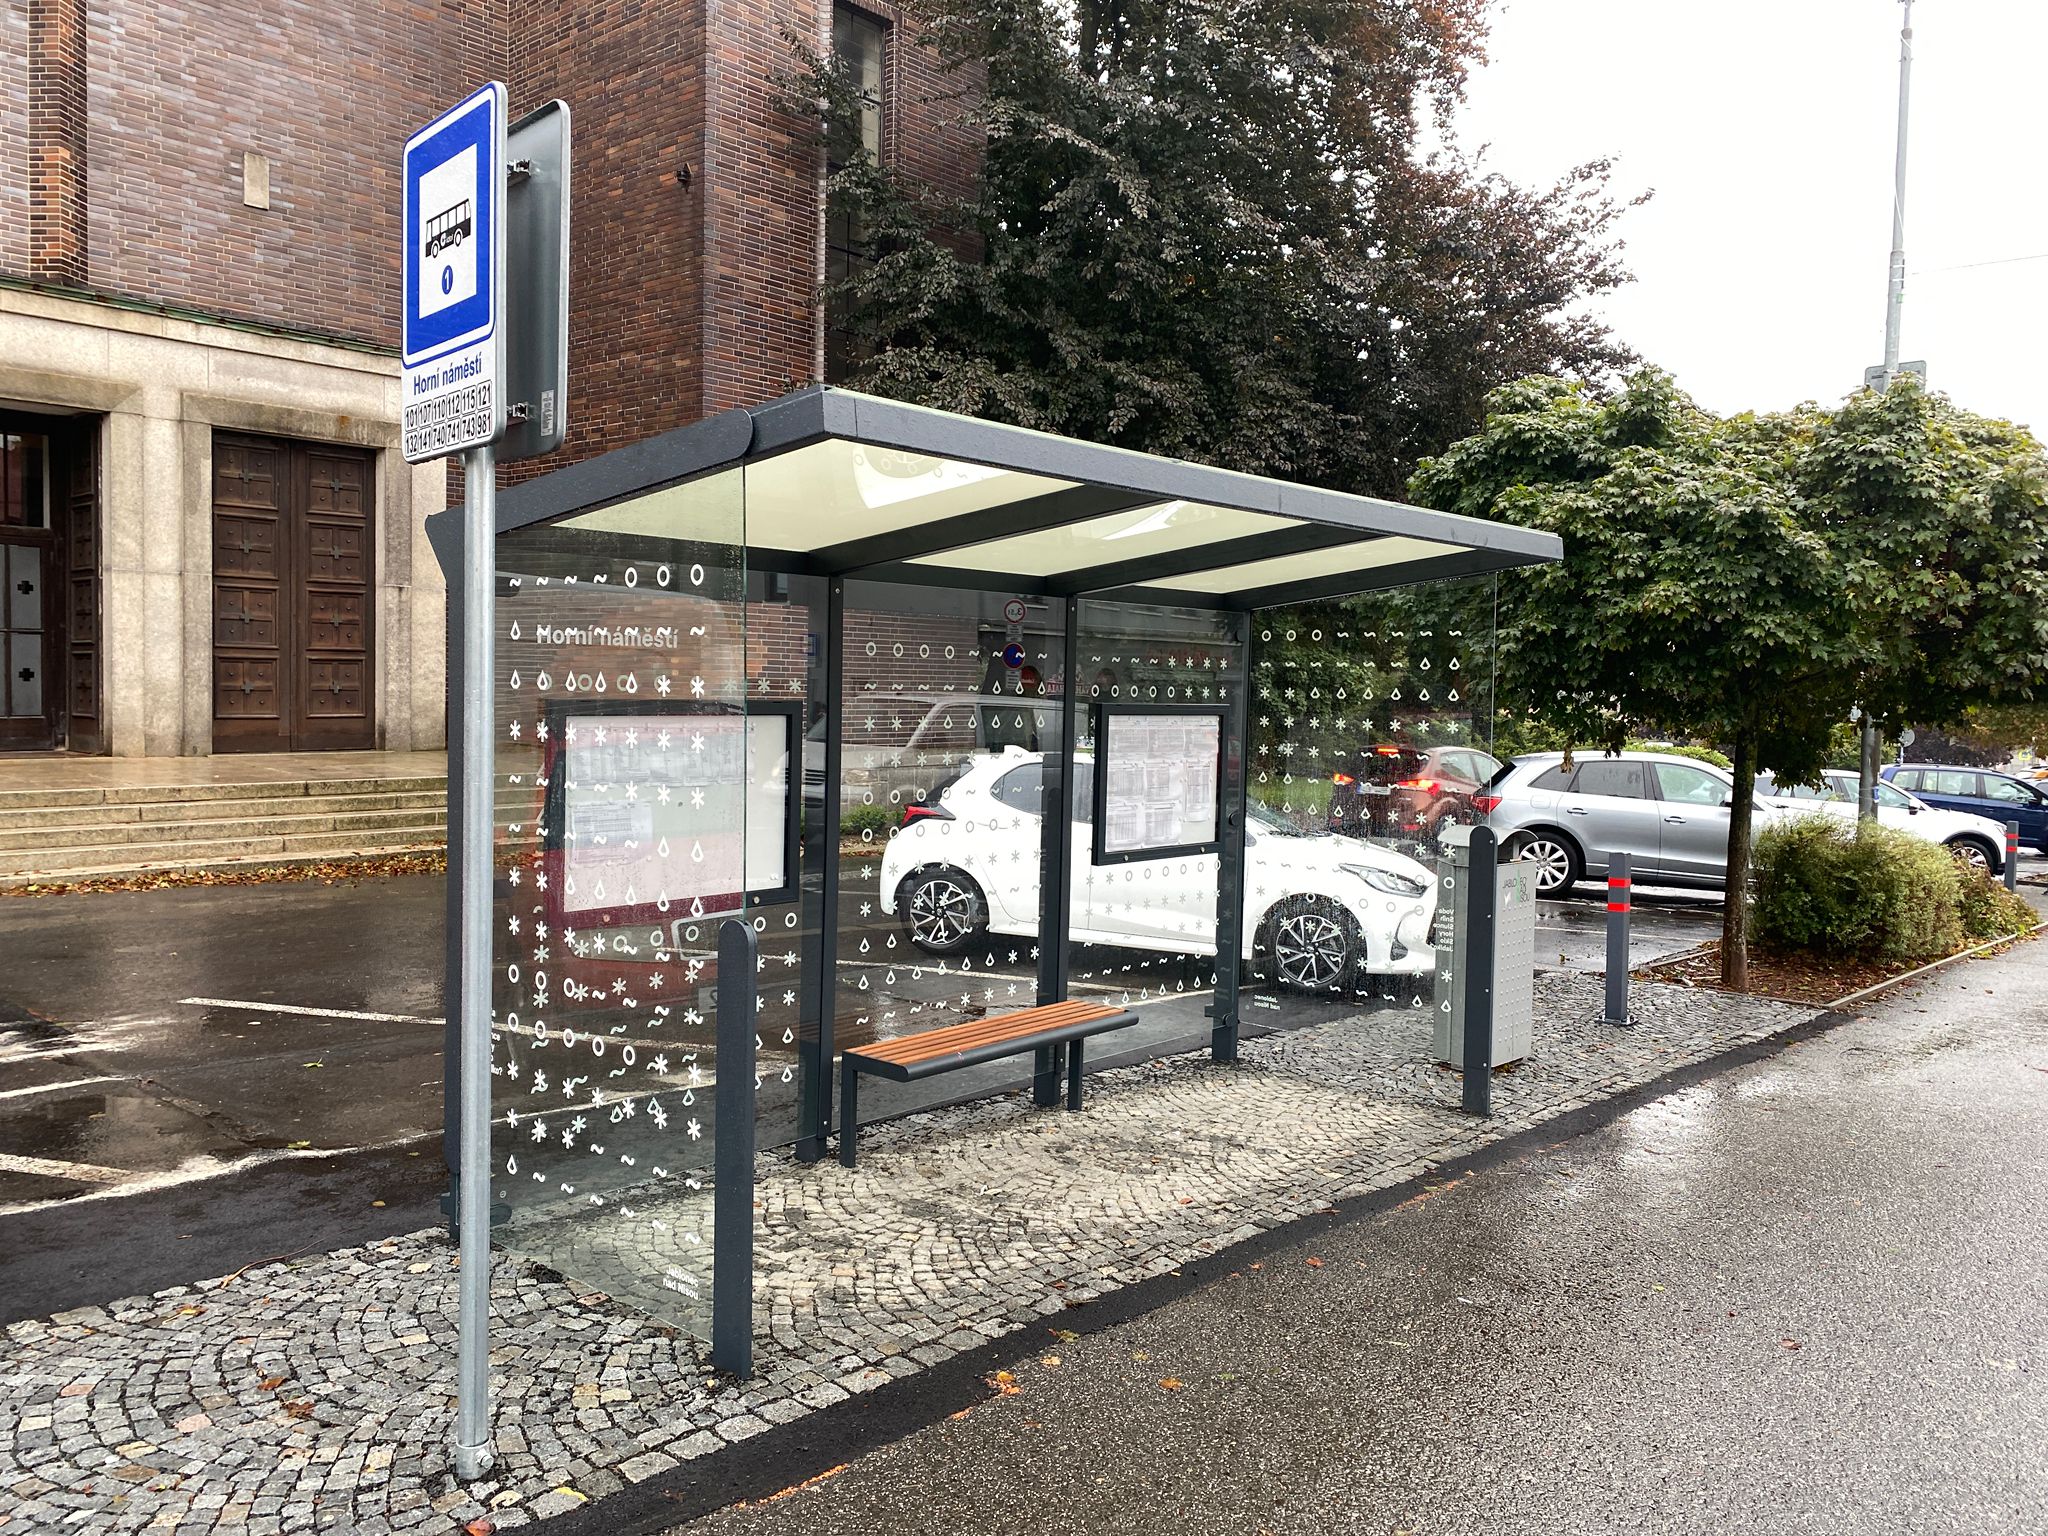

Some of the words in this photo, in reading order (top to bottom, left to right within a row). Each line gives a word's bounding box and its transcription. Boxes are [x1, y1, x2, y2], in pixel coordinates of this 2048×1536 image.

[414, 367, 440, 395] Horní
[442, 351, 482, 386] náměstí
[406, 408, 418, 428] 101
[419, 403, 431, 425] 107
[434, 399, 446, 420] 110
[448, 394, 460, 416] 112
[463, 389, 475, 411] 115
[478, 383, 491, 409] 121
[406, 434, 418, 454] 132
[419, 430, 431, 451] 141
[433, 426, 445, 447] 740
[447, 421, 460, 443] 741
[462, 417, 475, 439] 743
[477, 412, 491, 435] 981
[536, 624, 594, 645] Horní
[599, 625, 679, 649] náměstí
[662, 1277, 676, 1291] nad
[677, 1282, 699, 1301] Nisou
[666, 1264, 699, 1288] Jablonec
